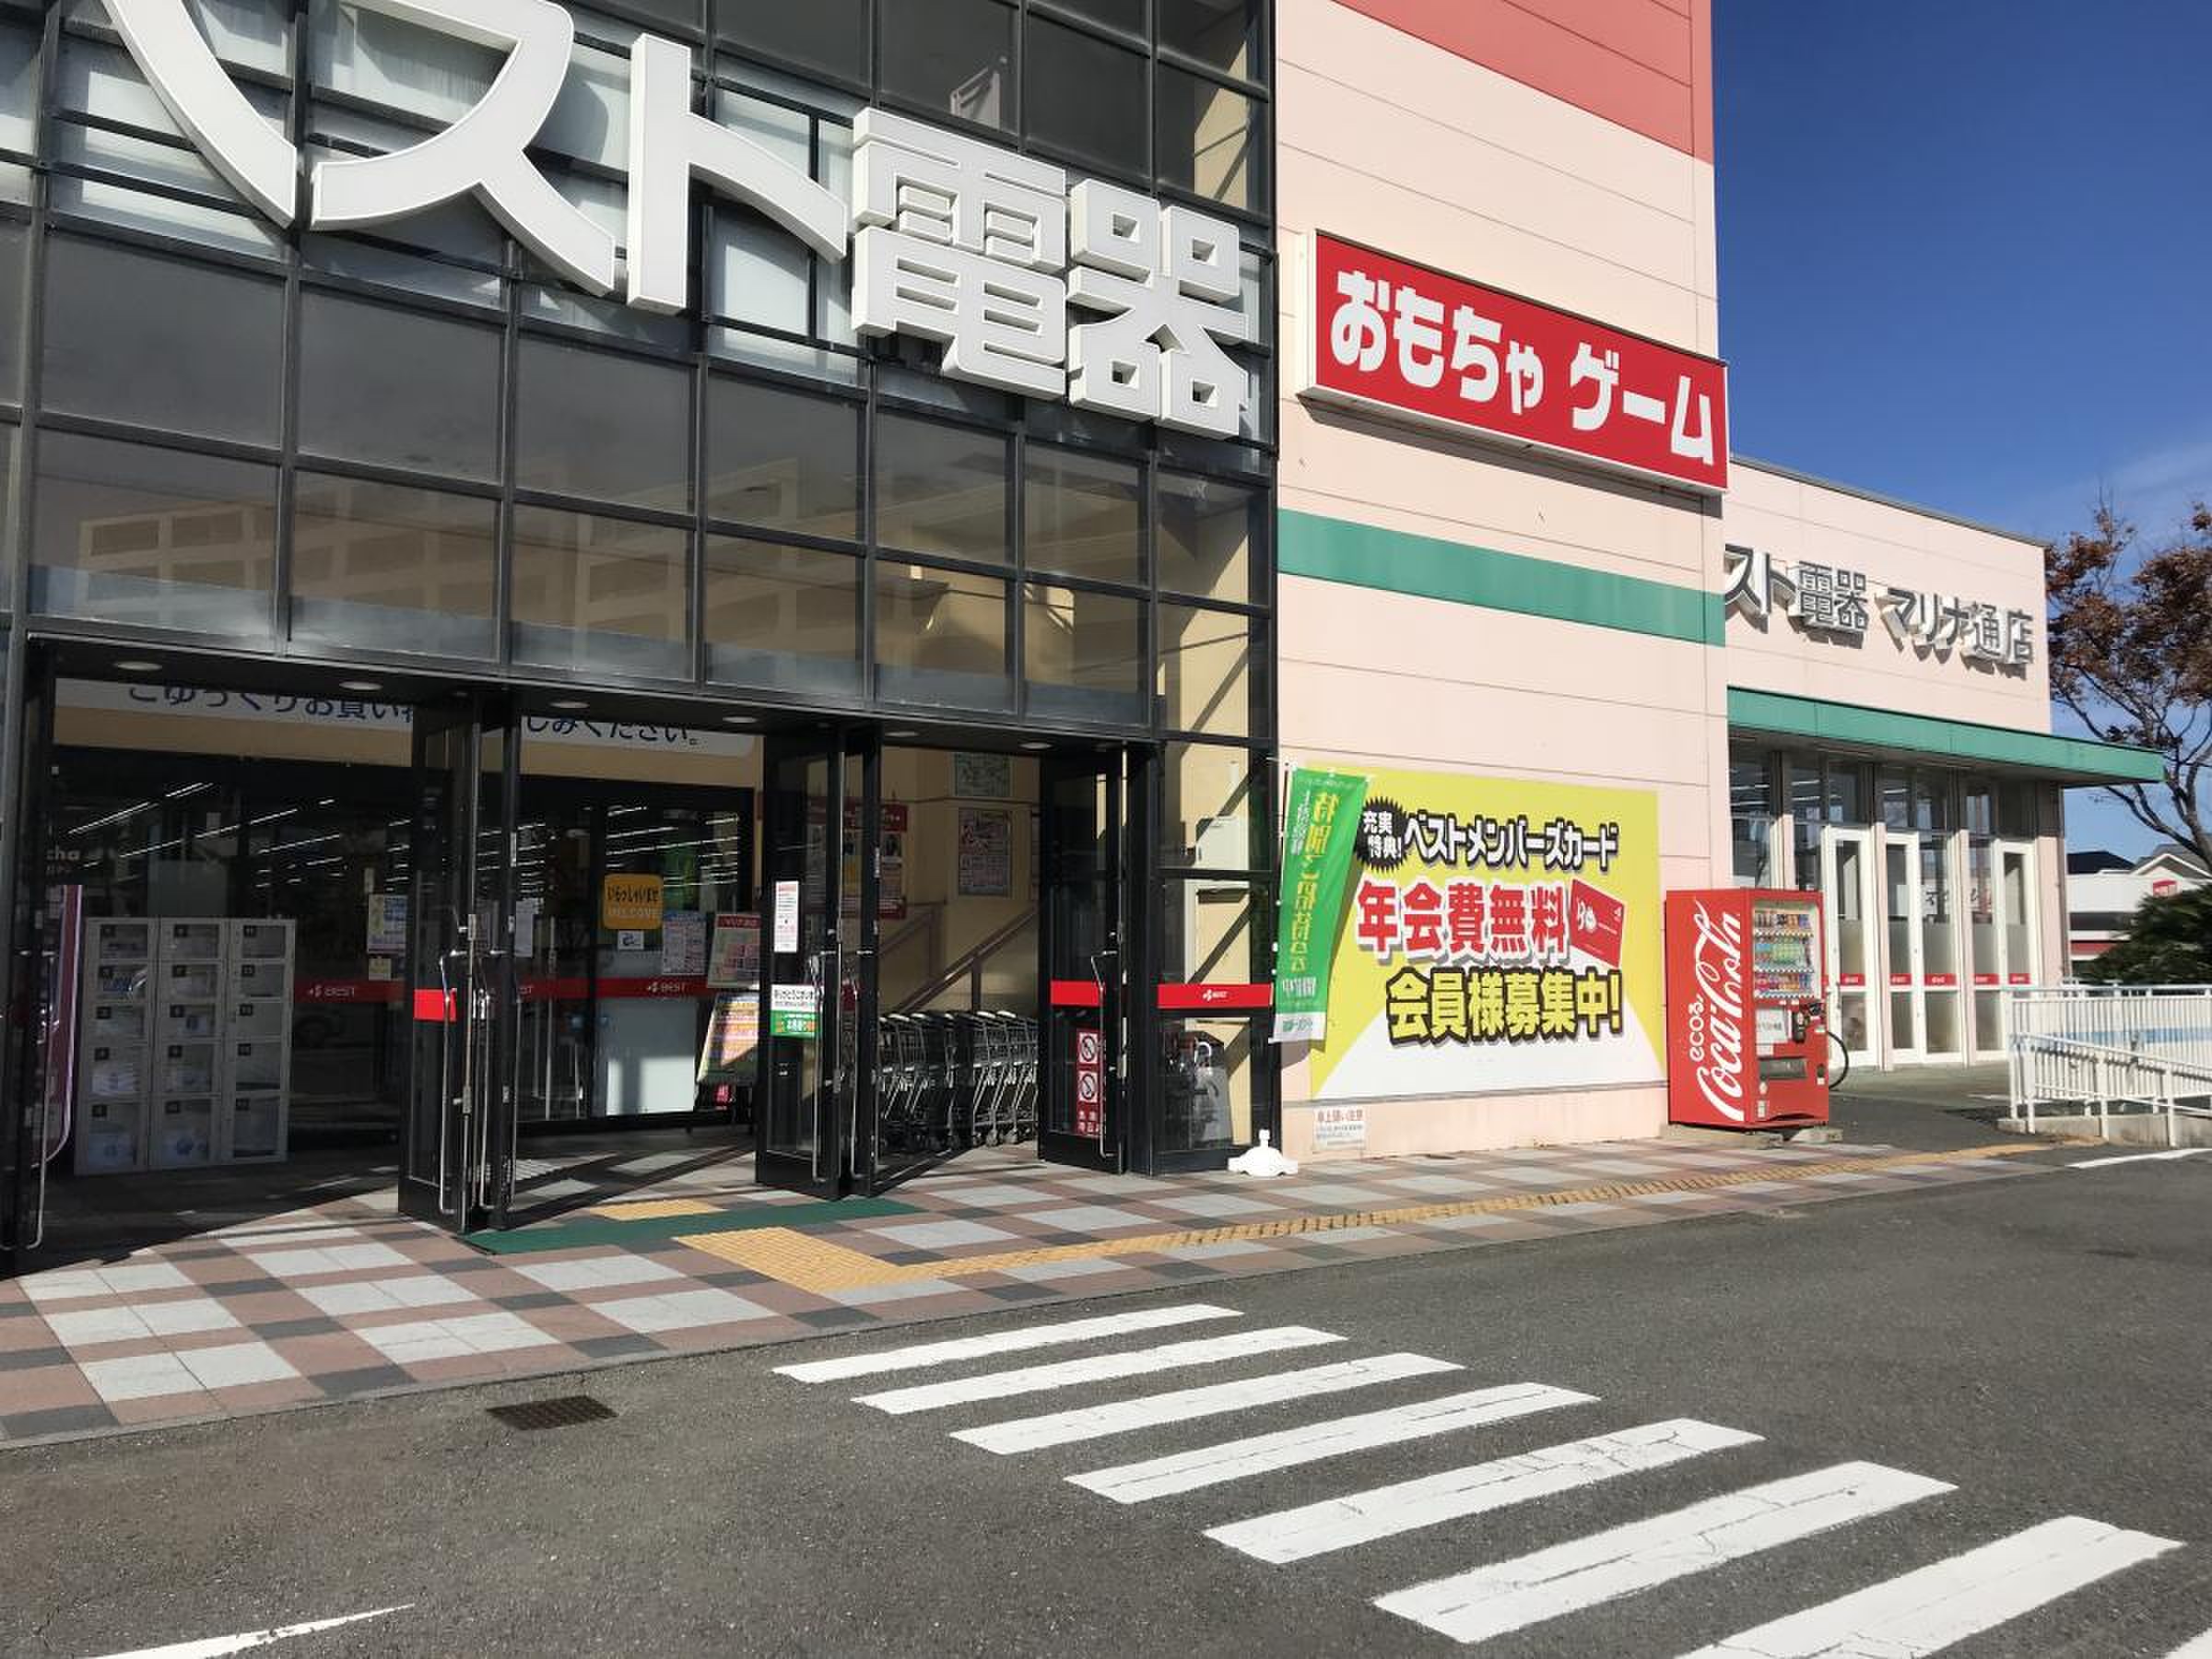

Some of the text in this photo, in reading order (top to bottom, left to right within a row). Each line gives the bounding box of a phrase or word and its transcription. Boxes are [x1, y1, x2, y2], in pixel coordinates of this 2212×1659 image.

[1330, 270, 1714, 465] おもちゃ ゲーム
[1877, 586, 2034, 665] マリナ通店
[1362, 810, 1394, 835] 充実
[1404, 810, 1619, 870] ベストメンバーズカード
[1357, 880, 1567, 957] 年会費無料
[1387, 968, 1622, 1045] 会員様募集中!
[1694, 898, 1745, 1122] Coca-Cola
